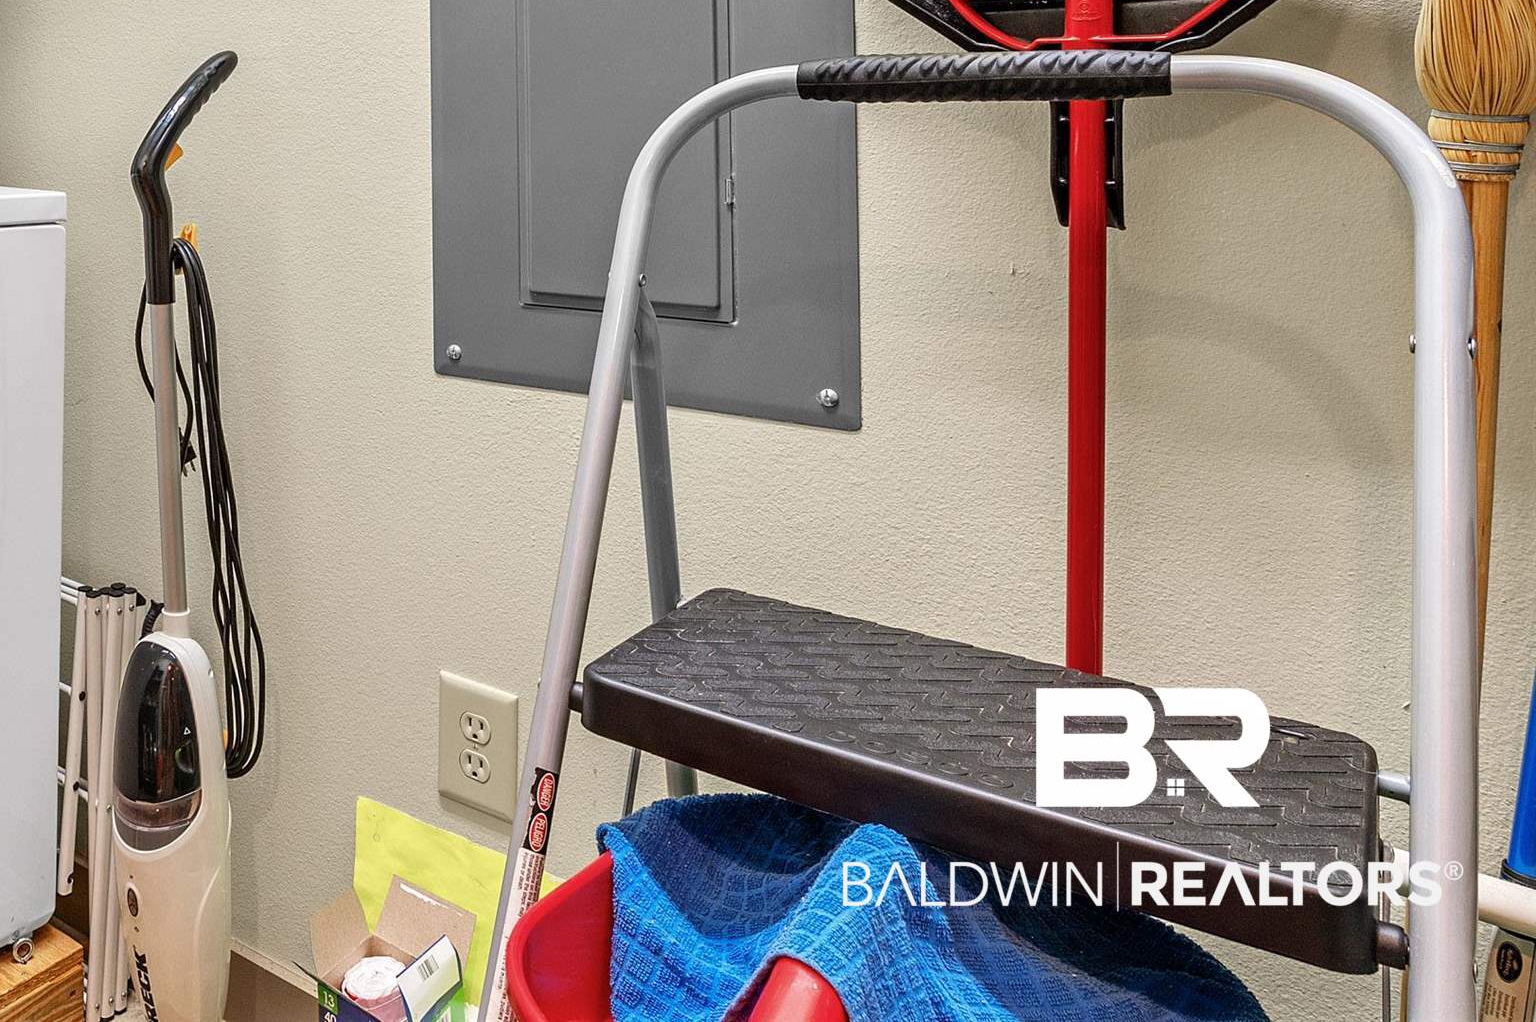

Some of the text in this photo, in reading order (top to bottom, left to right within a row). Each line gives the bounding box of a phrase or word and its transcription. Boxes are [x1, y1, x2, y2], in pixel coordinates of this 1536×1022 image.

[539, 778, 555, 806] DANGER
[531, 817, 545, 847] PELIGRO
[323, 991, 335, 1007] 13
